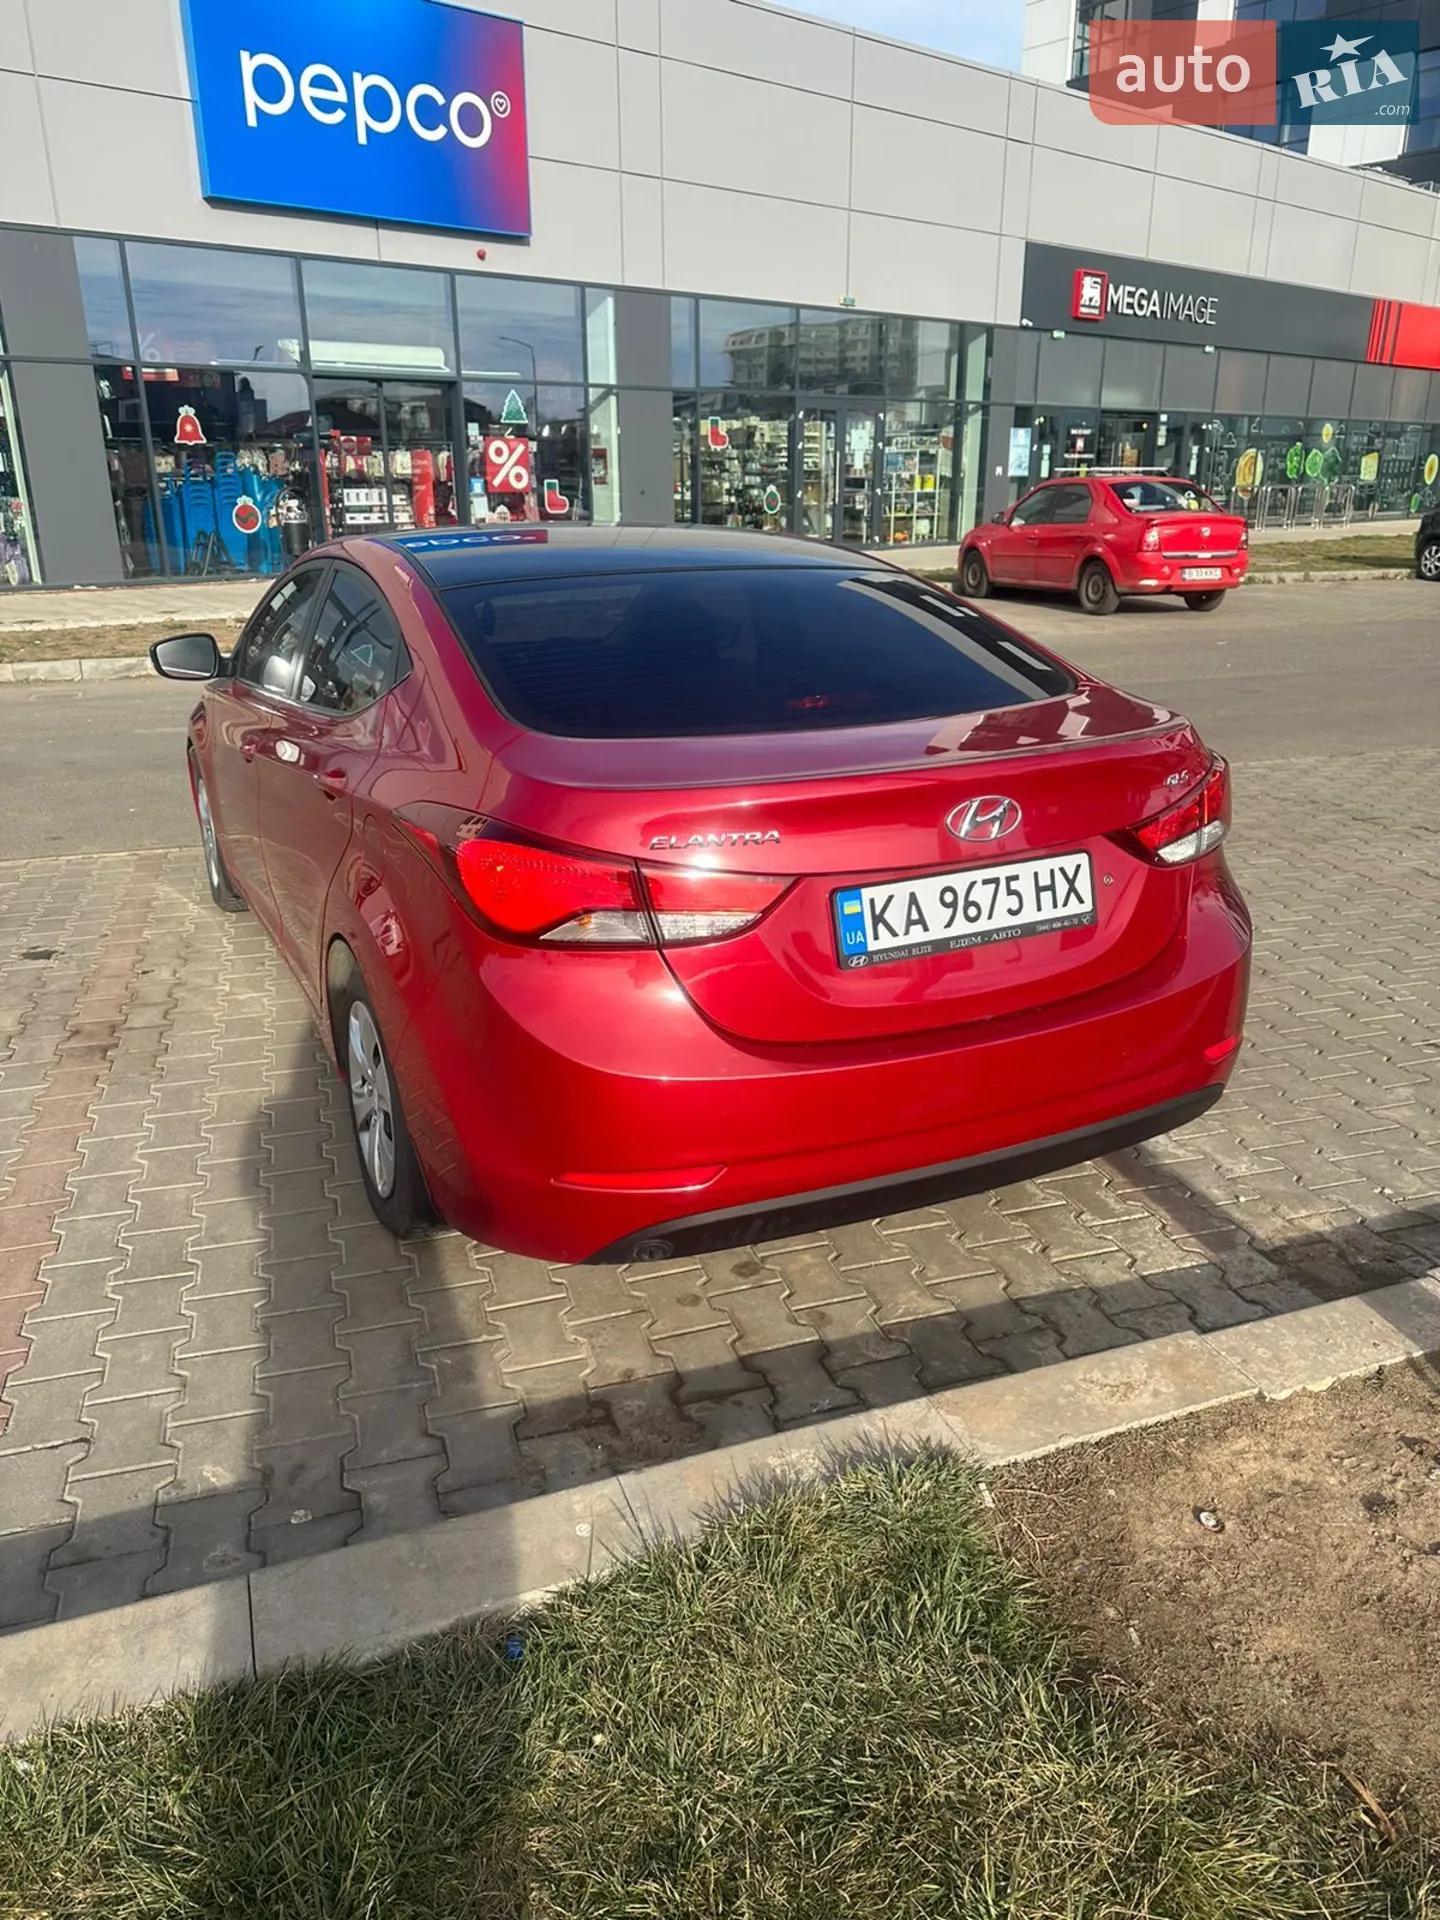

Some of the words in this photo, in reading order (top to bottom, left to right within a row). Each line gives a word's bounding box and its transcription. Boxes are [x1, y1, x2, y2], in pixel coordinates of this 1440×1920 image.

[239, 49, 493, 149] pepco
[1106, 282, 1161, 319] MEGA
[1162, 291, 1219, 326] IMAGE
[649, 830, 782, 850] ELANTRA
[846, 930, 865, 946] UA
[868, 890, 931, 942] KA
[938, 873, 1025, 930] 9675
[1032, 863, 1086, 913] HX
[872, 948, 909, 963] HYUNDAI
[912, 945, 933, 956] ELITE
[949, 935, 982, 950] ЕДЕМ
[990, 928, 1022, 942] АВТО
